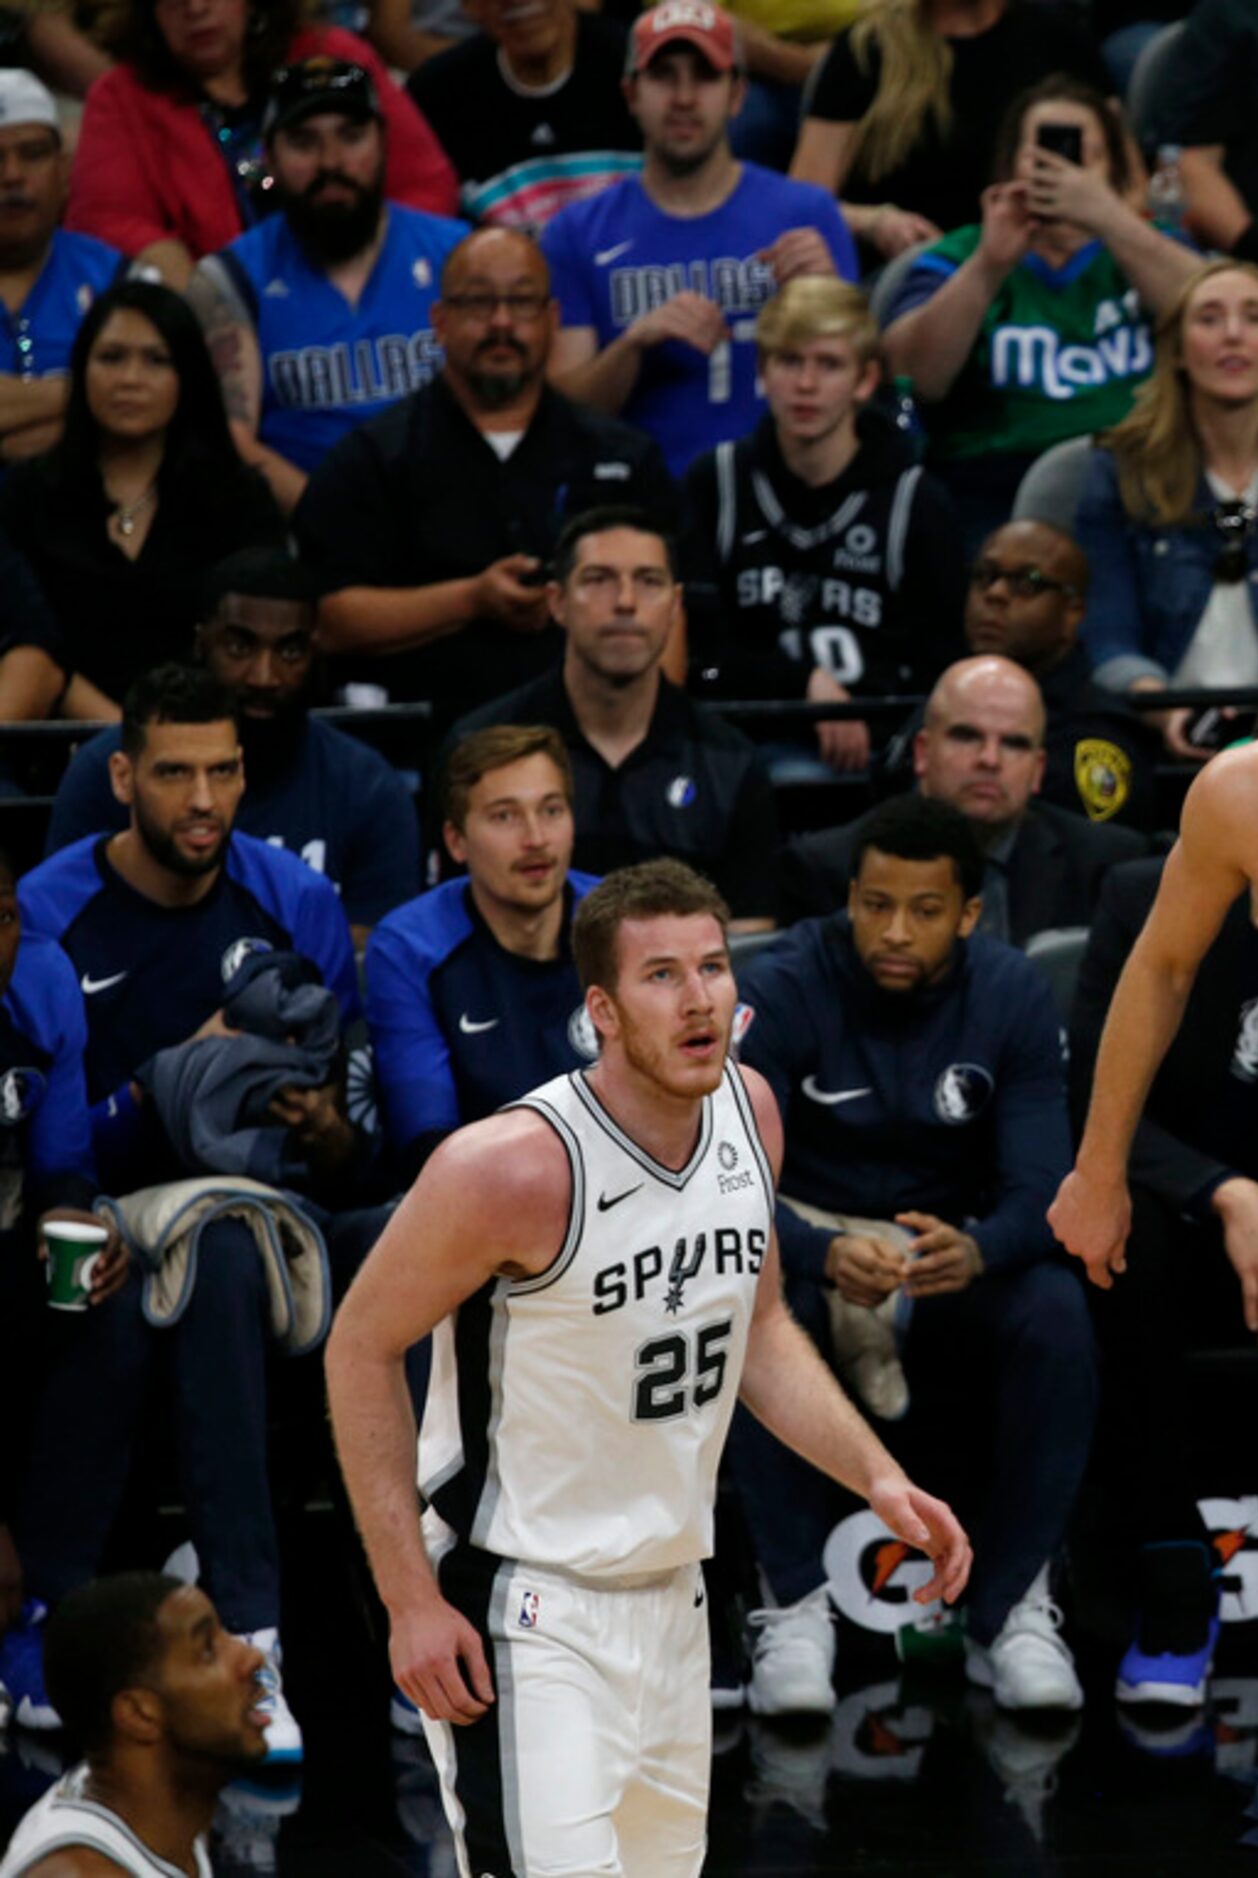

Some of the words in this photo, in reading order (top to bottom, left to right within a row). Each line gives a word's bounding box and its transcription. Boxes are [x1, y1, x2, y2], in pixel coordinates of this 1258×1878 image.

[268, 329, 446, 410] DALLAS
[737, 566, 882, 627] SPURS
[717, 1170, 754, 1195] Frost
[593, 1228, 766, 1315] SPURS
[631, 1314, 735, 1423] 25
